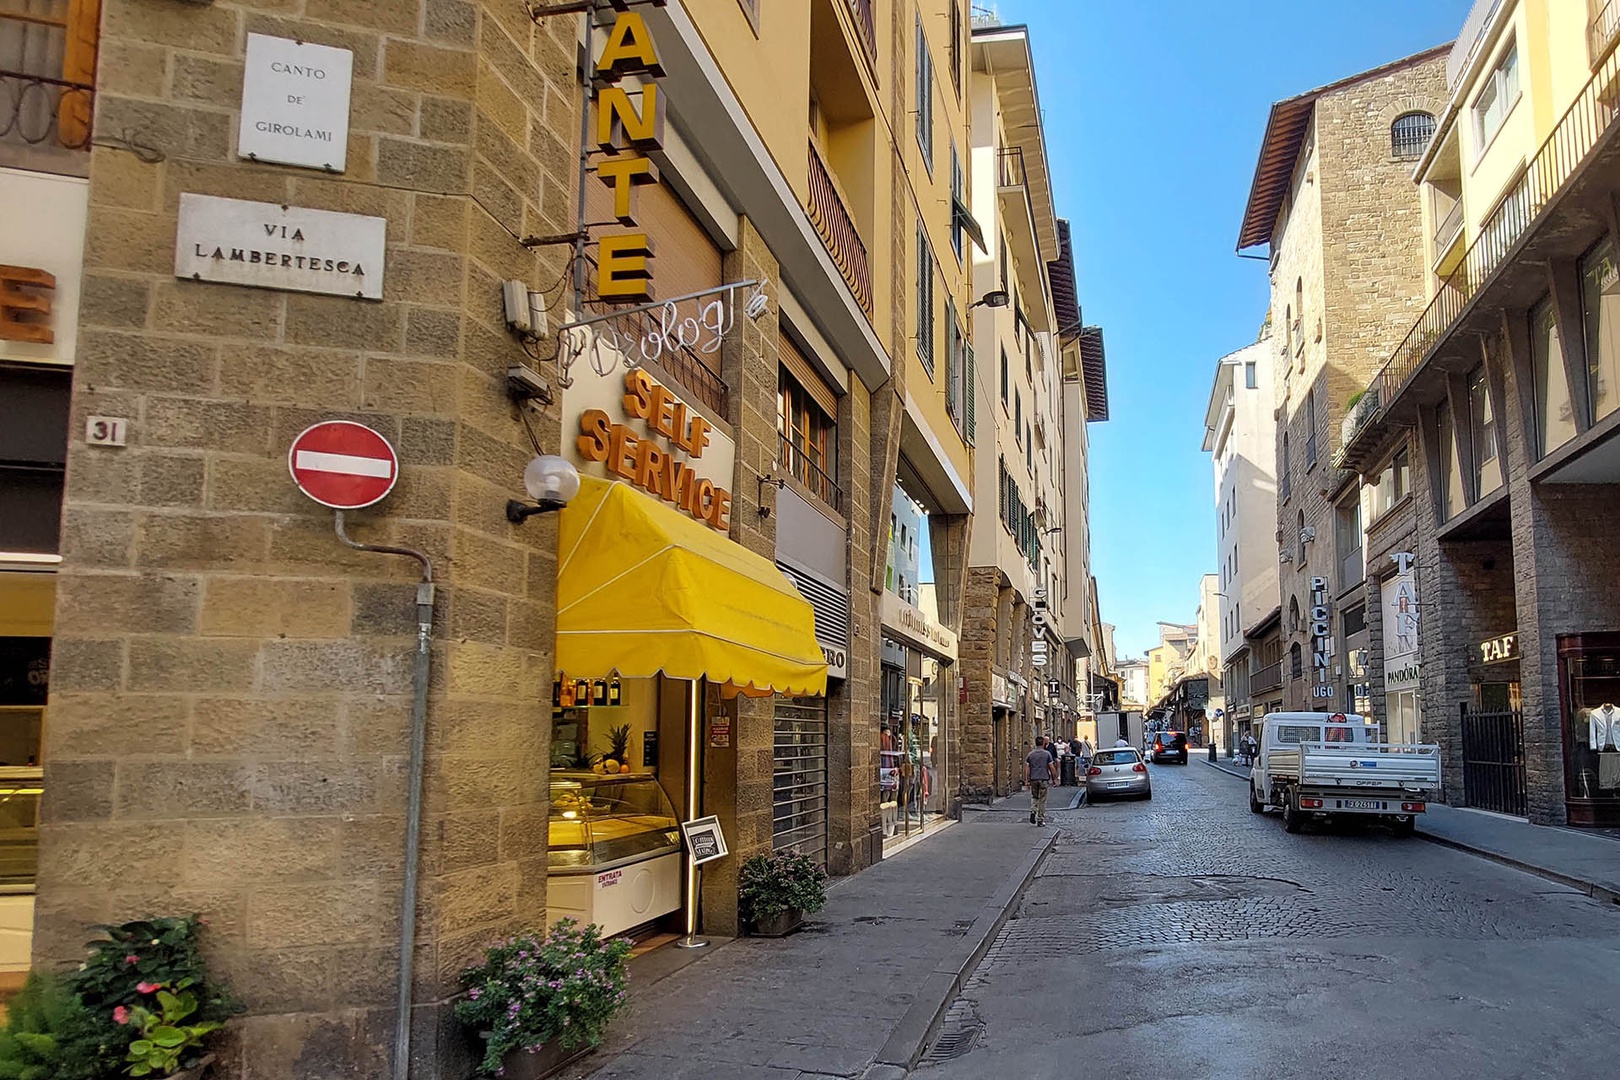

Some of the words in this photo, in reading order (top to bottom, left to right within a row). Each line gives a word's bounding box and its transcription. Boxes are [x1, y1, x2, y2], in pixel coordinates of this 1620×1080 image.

[270, 61, 326, 80] CANTO
[255, 121, 332, 142] GIROLAMI
[596, 0, 668, 305] ANTE
[263, 223, 305, 241] VIA
[195, 243, 365, 276] LAMBERTESCA
[623, 368, 712, 459] SELF
[93, 421, 118, 442] 31
[577, 409, 732, 532] SERVICE
[1389, 552, 1420, 637] TAF
[1310, 575, 1329, 683] PICCINI
[1480, 636, 1514, 662] TAF
[1387, 664, 1418, 685] PANDORA
[1313, 686, 1334, 698] UGO
[598, 870, 622, 884] ENTRATA
